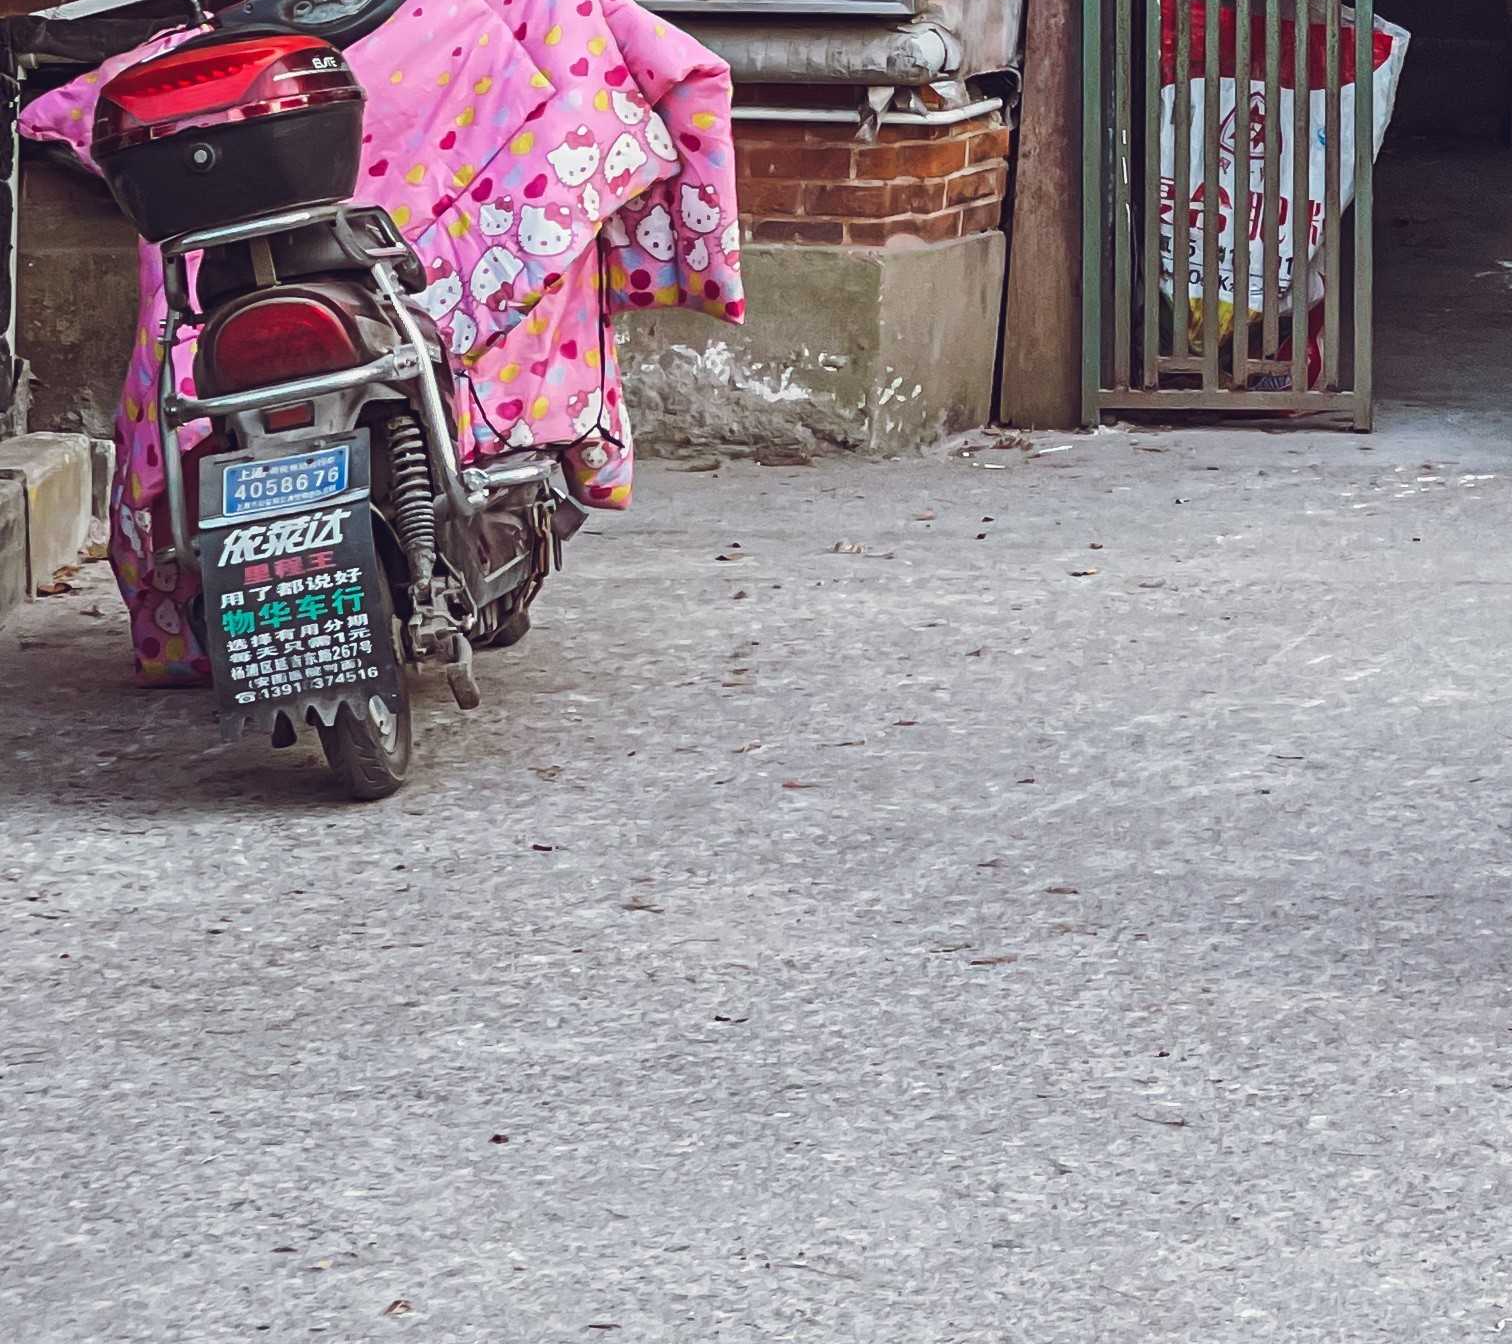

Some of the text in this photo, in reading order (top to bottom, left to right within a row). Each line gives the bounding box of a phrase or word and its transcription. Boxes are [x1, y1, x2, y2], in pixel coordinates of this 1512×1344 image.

[234, 466, 339, 500] 4058676
[243, 551, 337, 585] 里程王
[220, 568, 362, 609] 用了都说好
[222, 586, 365, 637] 物华车行
[227, 614, 369, 652] 选择有用分期
[229, 627, 371, 663] 每天只需1元
[260, 666, 378, 700] 1391374516
